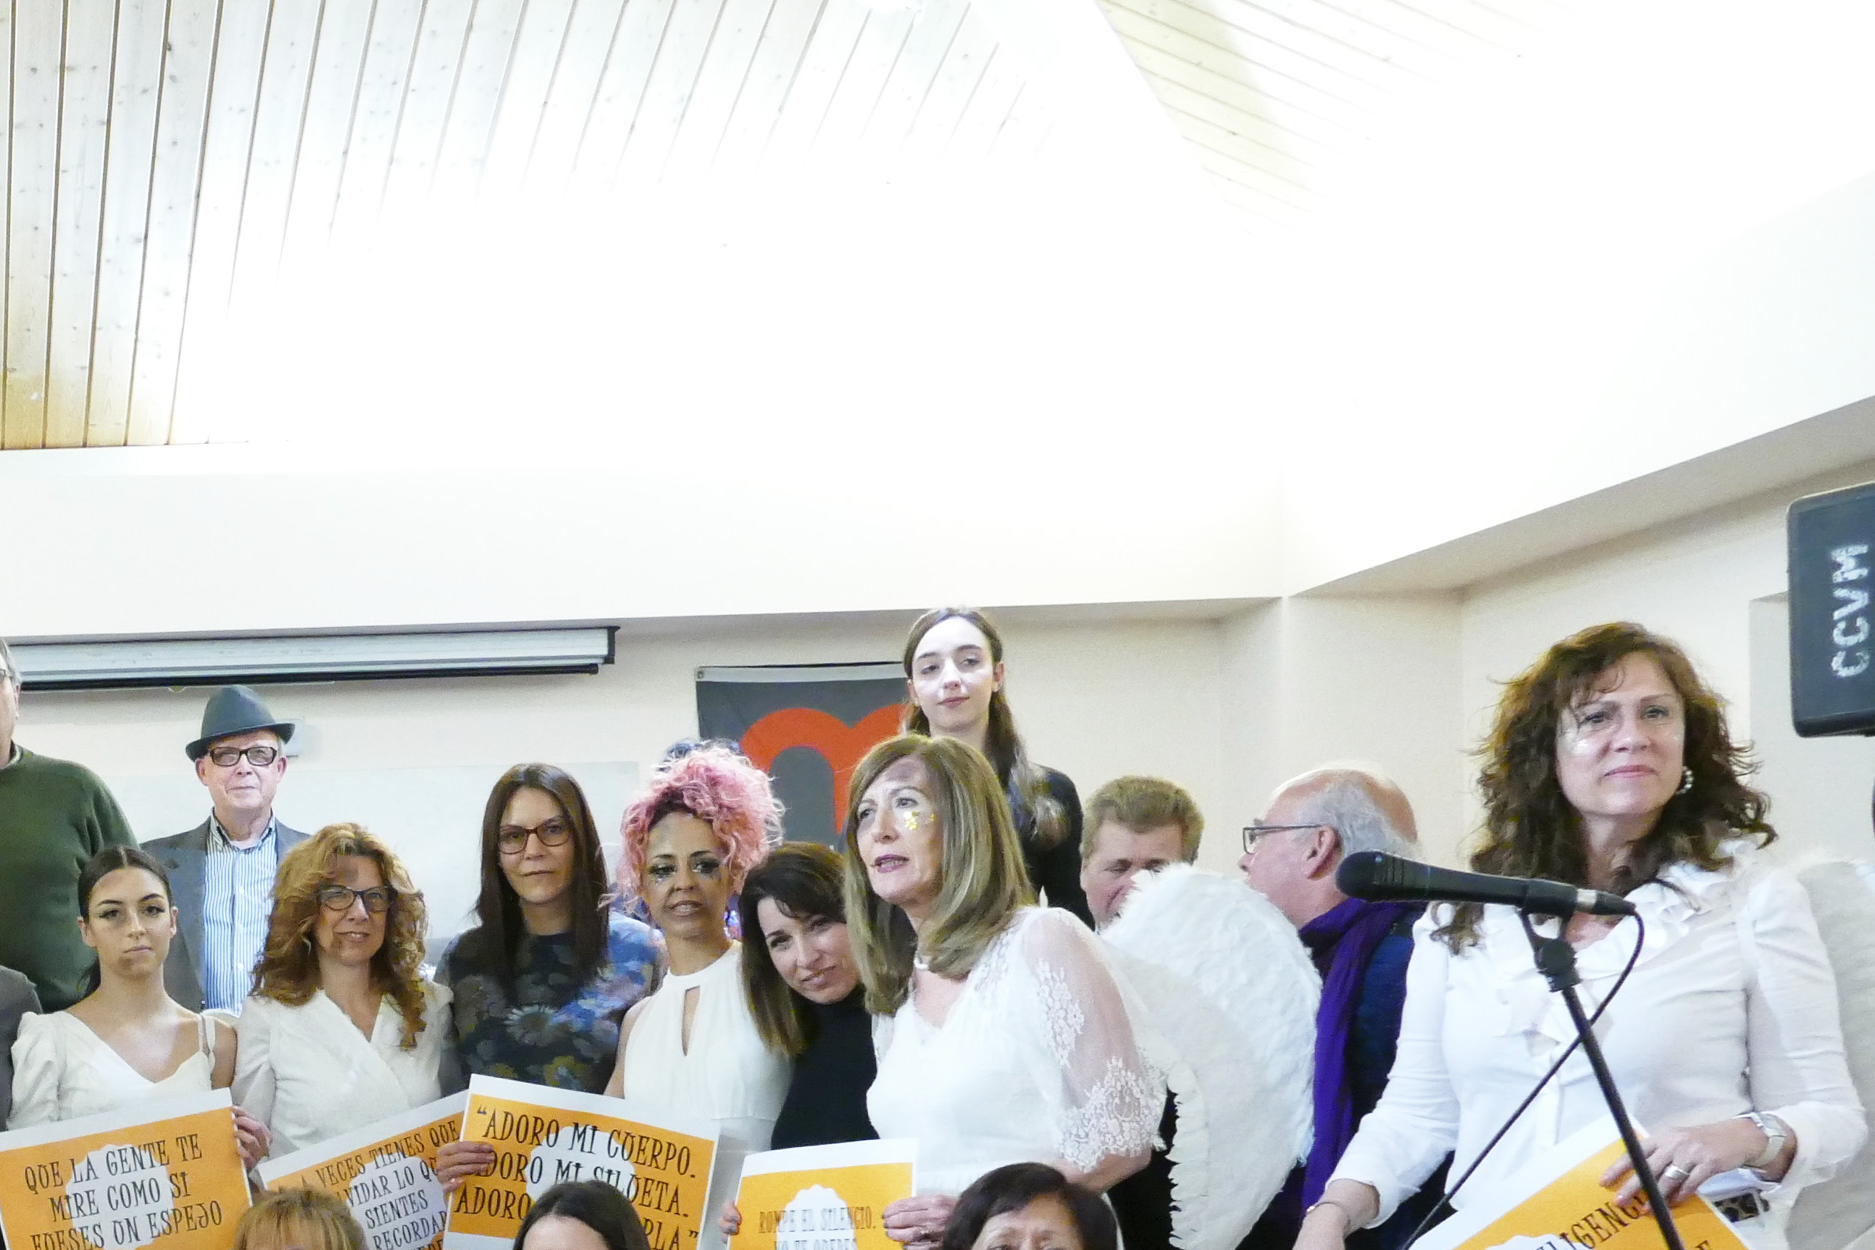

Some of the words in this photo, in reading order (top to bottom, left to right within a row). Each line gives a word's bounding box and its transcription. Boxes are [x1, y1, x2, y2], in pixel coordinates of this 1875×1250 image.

[1831, 544, 1870, 677] CCVM
[25, 1161, 64, 1195] QUE
[69, 1155, 99, 1183] LA
[106, 1140, 170, 1176] GENTE
[176, 1134, 203, 1162] TE
[315, 1154, 366, 1188] VECES
[369, 1133, 425, 1169] TIENES
[429, 1120, 460, 1147] QUE
[475, 1150, 543, 1185] DORO
[569, 1122, 600, 1154] MI
[607, 1128, 696, 1179] CUERPO.
[49, 1189, 99, 1222] MIRE
[107, 1177, 161, 1211] COMO
[169, 1172, 191, 1199] SI
[394, 1166, 414, 1191] LO
[112, 1216, 141, 1245] UN
[148, 1200, 222, 1239] ESPEJO
[364, 1189, 429, 1230] SIENTES
[453, 1183, 531, 1221] ADORO
[758, 1210, 796, 1233] ROMPE
[801, 1208, 815, 1232] EL
